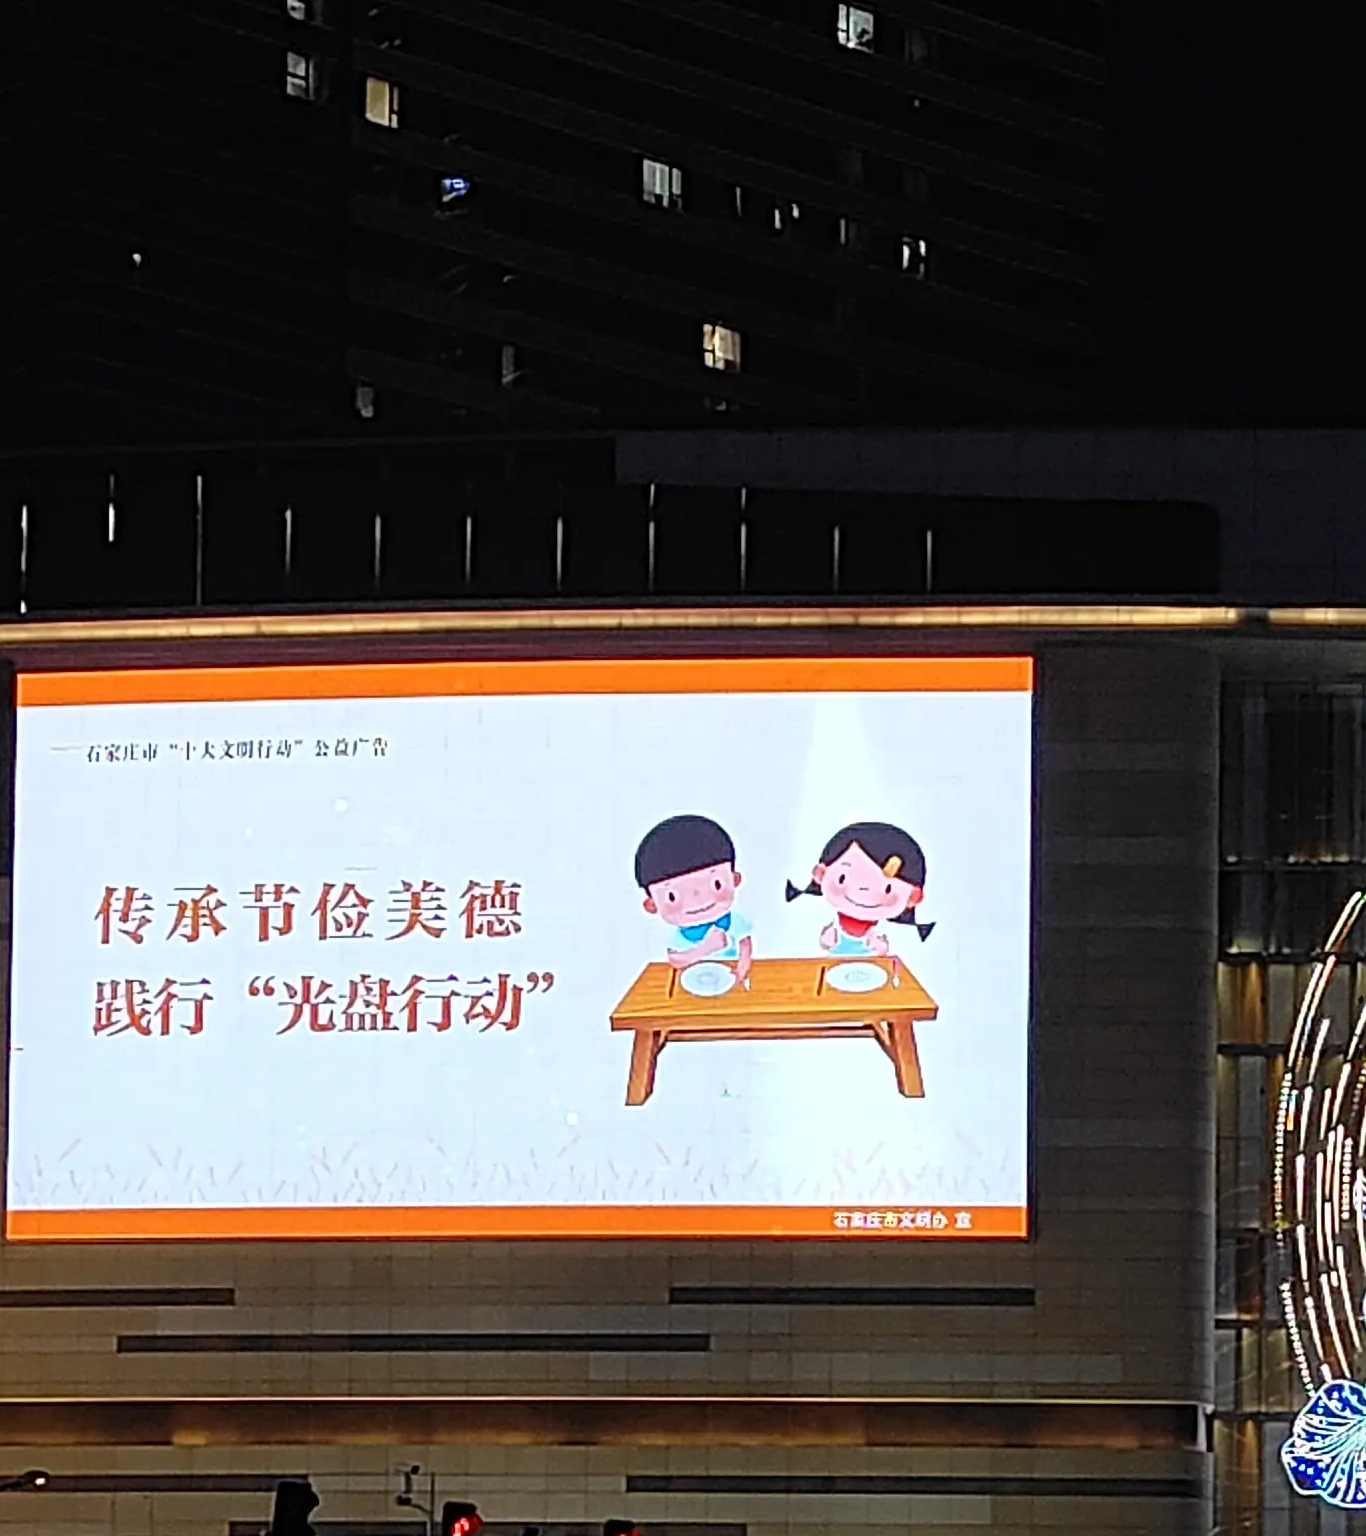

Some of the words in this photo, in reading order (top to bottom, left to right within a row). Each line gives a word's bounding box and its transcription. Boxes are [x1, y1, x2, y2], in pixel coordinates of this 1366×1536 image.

[92, 879, 523, 946] 传承节俭美德
[91, 971, 556, 1038] 践行“光盘行动”
